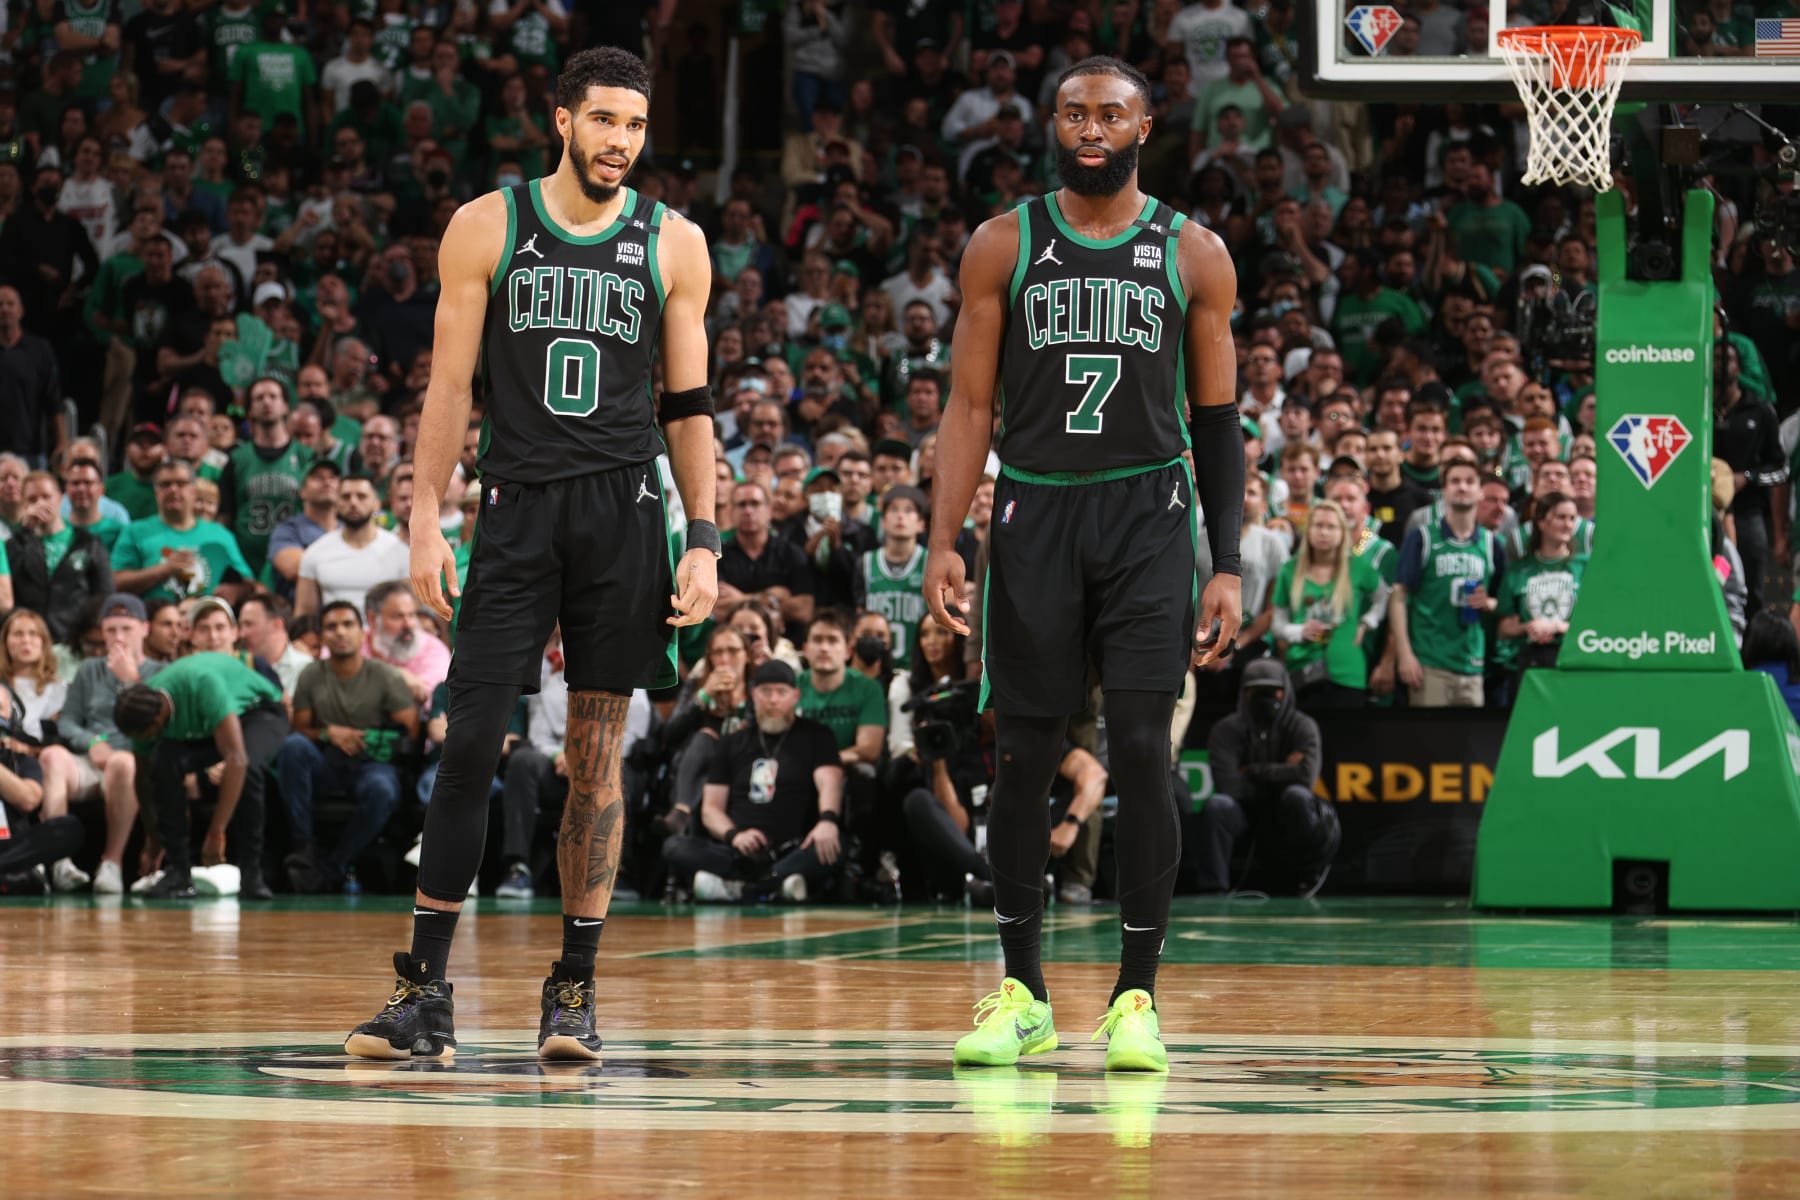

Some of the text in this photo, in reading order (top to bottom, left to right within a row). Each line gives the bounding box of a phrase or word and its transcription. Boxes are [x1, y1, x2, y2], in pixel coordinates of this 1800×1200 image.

[615, 254, 644, 266] PRINT
[616, 242, 645, 256] VISTA
[1133, 245, 1162, 260] VISTA
[1133, 258, 1162, 269] PRINT
[508, 267, 645, 344] CELTICS
[1024, 277, 1165, 353] CELTICS
[1605, 343, 1696, 363] coinbase
[544, 337, 601, 417] 0
[1065, 353, 1122, 434] 7
[1656, 425, 1674, 449] 75
[1577, 629, 1716, 659] Google Pixel
[1532, 726, 1750, 782] KIA
